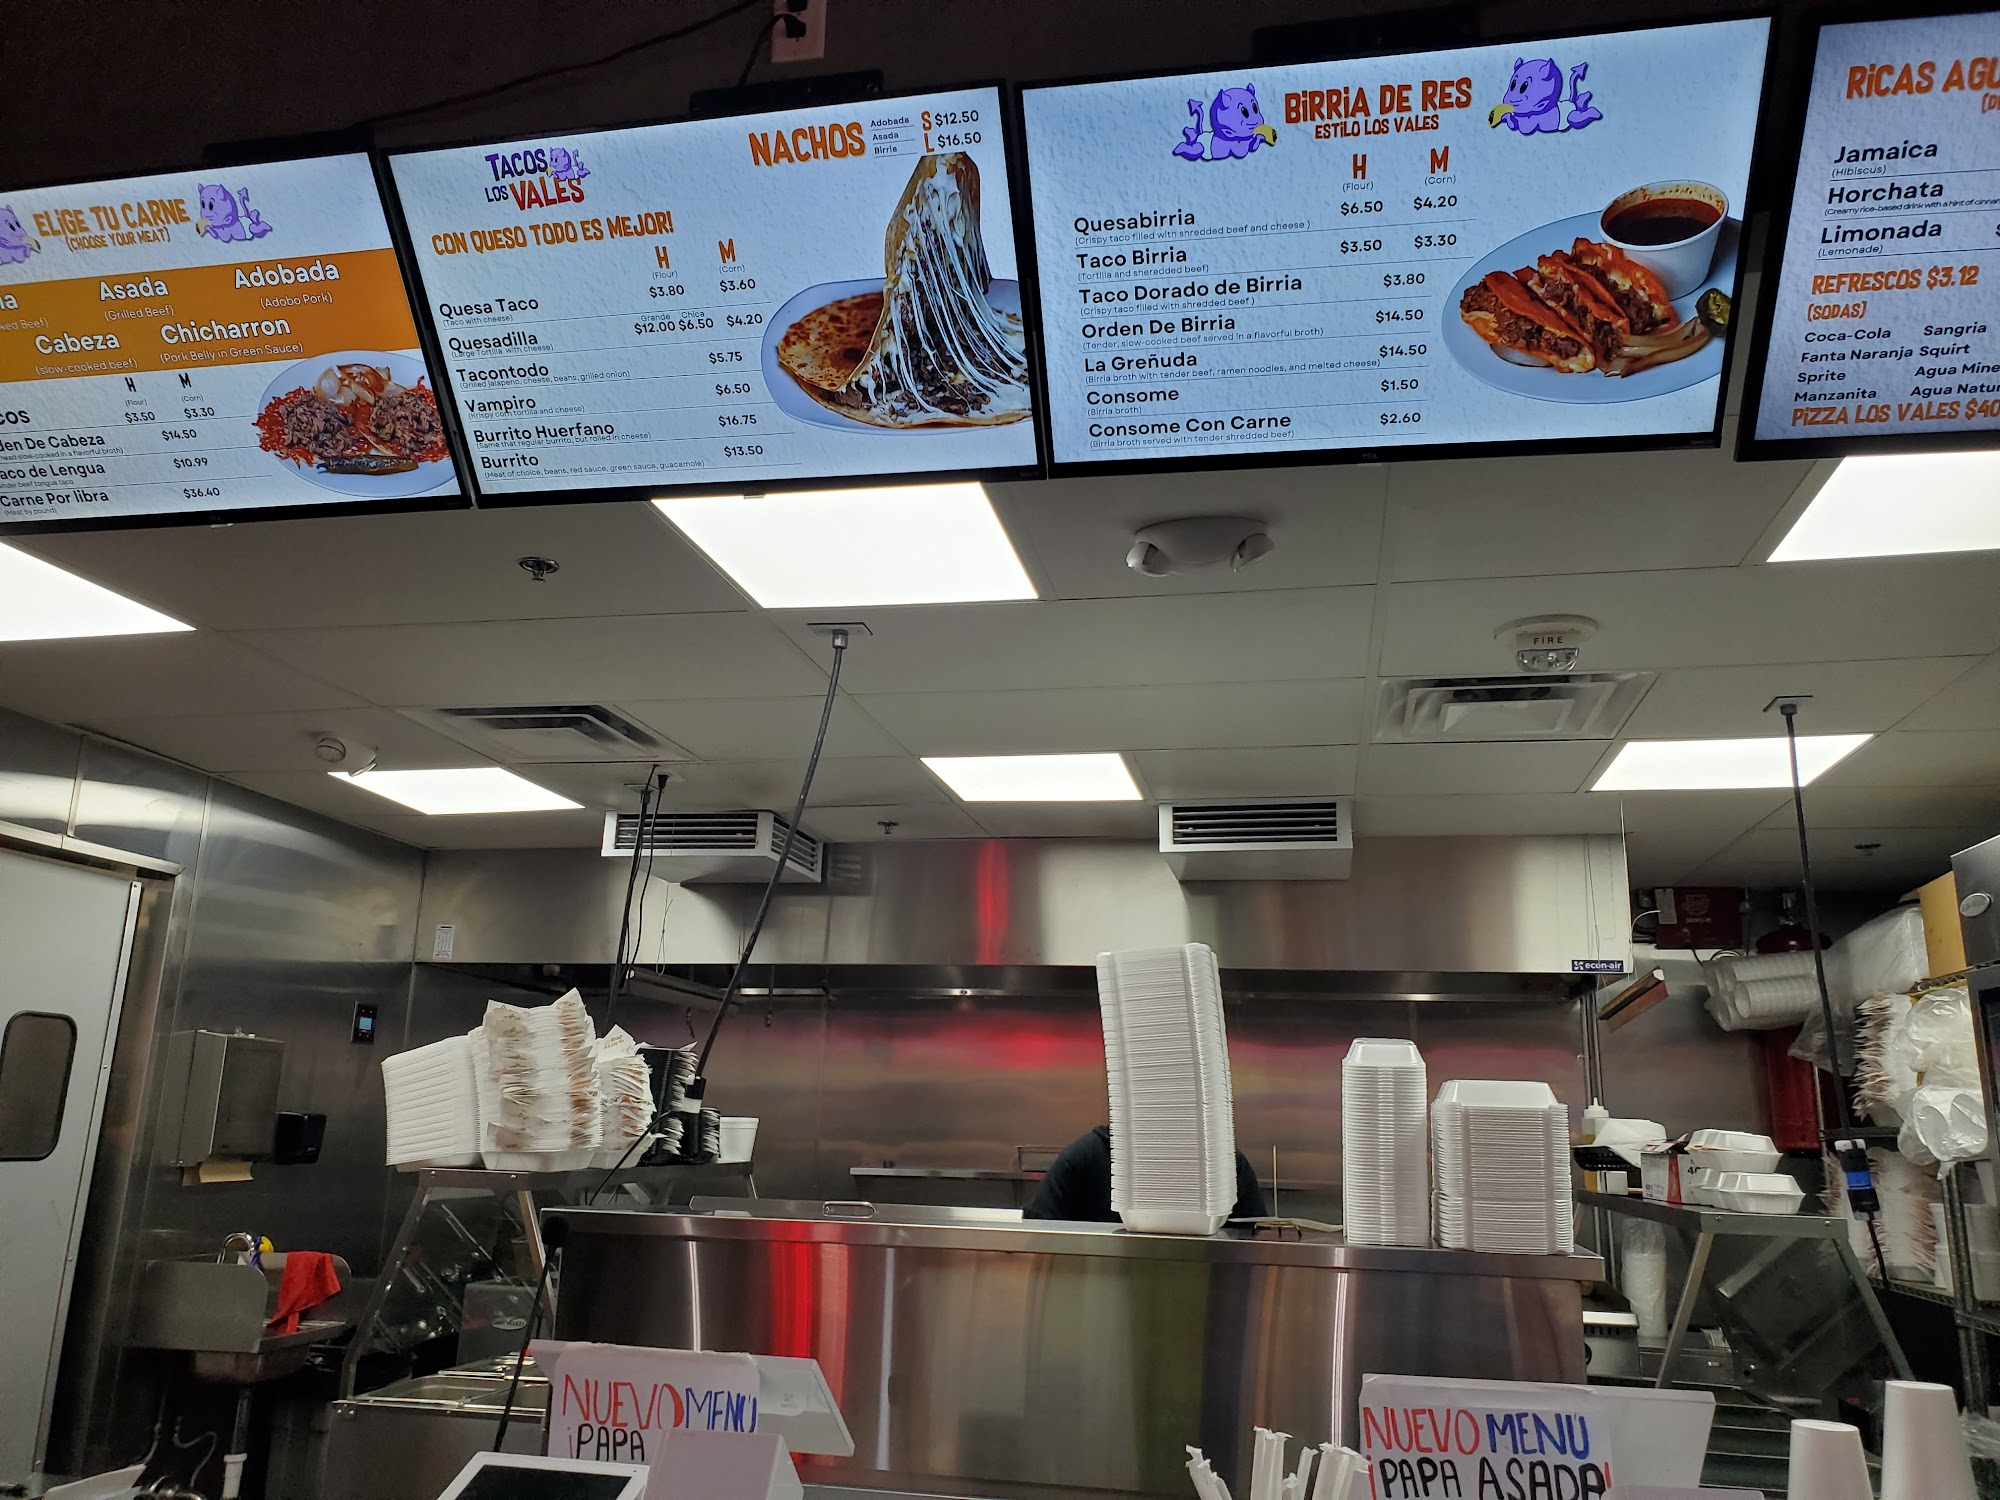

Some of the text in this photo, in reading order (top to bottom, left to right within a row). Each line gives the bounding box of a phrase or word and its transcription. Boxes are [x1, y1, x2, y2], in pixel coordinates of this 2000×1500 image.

[1380, 85, 1412, 115] DE
[1422, 77, 1472, 112] RES
[870, 117, 909, 127] Adobada
[921, 110, 979, 131] S $12.50
[1365, 118, 1389, 135] LOS
[1394, 115, 1439, 132] VALES
[872, 132, 899, 141] Asada
[924, 132, 982, 153] L $16.50
[748, 122, 866, 167] NACHOS
[874, 146, 897, 154] Birria
[1834, 140, 1938, 164] Jamaica
[484, 149, 548, 182] TACOS
[1352, 154, 1367, 179] H
[1430, 146, 1449, 174] M
[1832, 165, 1886, 178] (Hibiscus)
[1342, 181, 1374, 192] (Flour)
[1424, 175, 1456, 186] (Corn)
[484, 176, 585, 211] LOS VALES
[1828, 182, 1944, 204] Horchata
[1341, 201, 1383, 216] $6.50
[1414, 195, 1457, 211] $4.20
[89, 206, 120, 231] TU
[121, 199, 191, 229] CARNE
[1074, 209, 1195, 236] Quesabirria
[65, 226, 171, 252] (CHOOSE YOUR MEAT)
[432, 211, 674, 256] CON QUESO TODO ES MEJOR!
[1821, 220, 1942, 244] Limonada
[1340, 240, 1382, 254] $3.50
[1415, 234, 1457, 249] $3.30
[655, 246, 670, 269] H
[718, 239, 736, 263] M
[1076, 247, 1187, 269] Taco Birria
[1818, 245, 1883, 257] (Lemonade)
[235, 260, 340, 289] Adobada
[652, 271, 678, 280] (Flour)
[719, 264, 746, 274] (Corn)
[720, 278, 756, 292] $3.60
[1383, 273, 1425, 288] $3.80
[1812, 269, 1922, 295] REFRESCOS
[100, 277, 169, 301] Asada
[649, 285, 685, 299] $3.80
[1079, 275, 1302, 304] Taco Dorado de Birria
[260, 292, 333, 310] (Adobo Pork)
[104, 305, 174, 321] (Grilled Beef)
[439, 299, 539, 320] Quesa Taco
[681, 311, 705, 319] Chica
[1376, 309, 1424, 324] $14.50
[1808, 301, 1867, 322] (SODAS)
[641, 313, 670, 322] Grande
[678, 318, 714, 331] $6.50
[727, 314, 763, 327] $4.20
[161, 319, 291, 344] Chicharron
[634, 321, 676, 335] $12.00
[1082, 315, 1235, 339] Orden De Birria
[1924, 322, 1987, 337] Sangria
[449, 332, 538, 353] Quesadilla
[1804, 328, 1891, 342] Coca-Cola
[35, 332, 120, 354] Cabeza
[160, 342, 303, 365] (Pork Belly in Green Sauce)
[709, 351, 743, 364] $5.75
[1379, 344, 1427, 358] $14.50
[1801, 347, 1913, 363] Fanta Naranja
[1919, 344, 1970, 358] Squirt
[36, 358, 138, 376] (slow-cooked beef)
[1085, 352, 1197, 373] La Greñuda
[456, 363, 549, 382] Tacontodo
[1798, 370, 1846, 384] Sprite
[1914, 366, 1957, 378] Agua
[125, 377, 136, 392] H
[178, 373, 192, 388] M
[1381, 379, 1419, 392] $1.50
[716, 383, 750, 396] $6.50
[1087, 389, 1179, 405] Consome
[1794, 388, 1877, 402] Manzanita
[1910, 386, 1952, 398] Agua
[125, 399, 148, 407] (Flour)
[181, 395, 204, 403] (Corn)
[464, 395, 536, 413] Vampiro
[125, 412, 156, 423] $3.50
[184, 407, 215, 419] $3.30
[1088, 406, 1142, 417] (Birria broth)
[1380, 412, 1421, 426] $2.60
[1855, 404, 1890, 423] LOS
[1898, 401, 1960, 421] VALES
[719, 415, 757, 427] $16.75
[1089, 416, 1291, 438] Consome Con Carne
[162, 429, 197, 442] $14.50
[474, 422, 615, 443] Burrito Huerfano
[25, 437, 46, 450] De
[48, 434, 105, 448] Cabeza
[724, 445, 763, 457] $13.50
[173, 458, 208, 469] $10.99
[481, 453, 539, 469] Burrito
[29, 465, 47, 477] de
[51, 464, 105, 479] Lengua
[1, 490, 109, 507] Carne Por libra
[183, 488, 220, 499] $36.40
[1534, 637, 1563, 645] FIRE
[1585, 961, 1622, 969] econ-air
[562, 1374, 684, 1429] NUEVO
[1362, 1407, 1480, 1455] NUEVO
